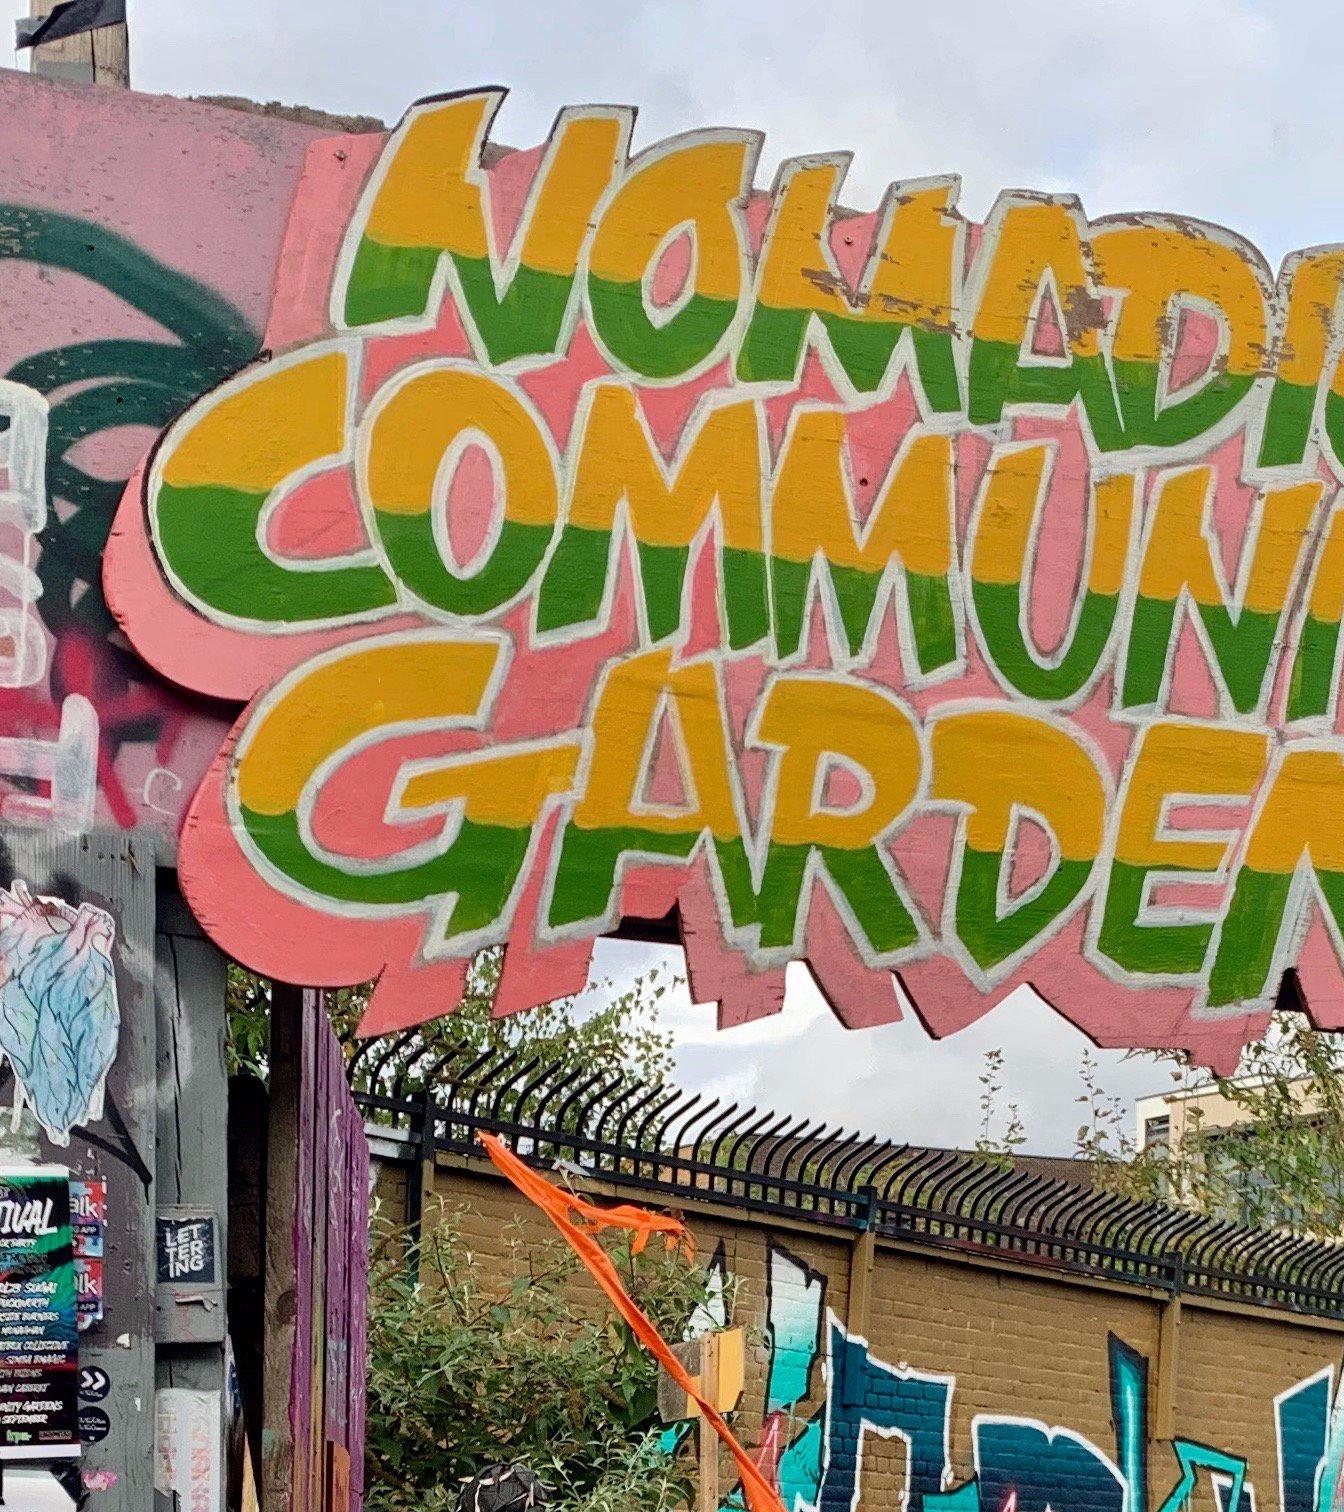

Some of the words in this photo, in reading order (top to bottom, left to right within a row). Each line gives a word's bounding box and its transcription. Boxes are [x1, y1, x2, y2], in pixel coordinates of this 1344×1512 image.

[164, 1224, 201, 1247] LET
[165, 1239, 204, 1266] TER
[169, 1255, 204, 1278] ING
